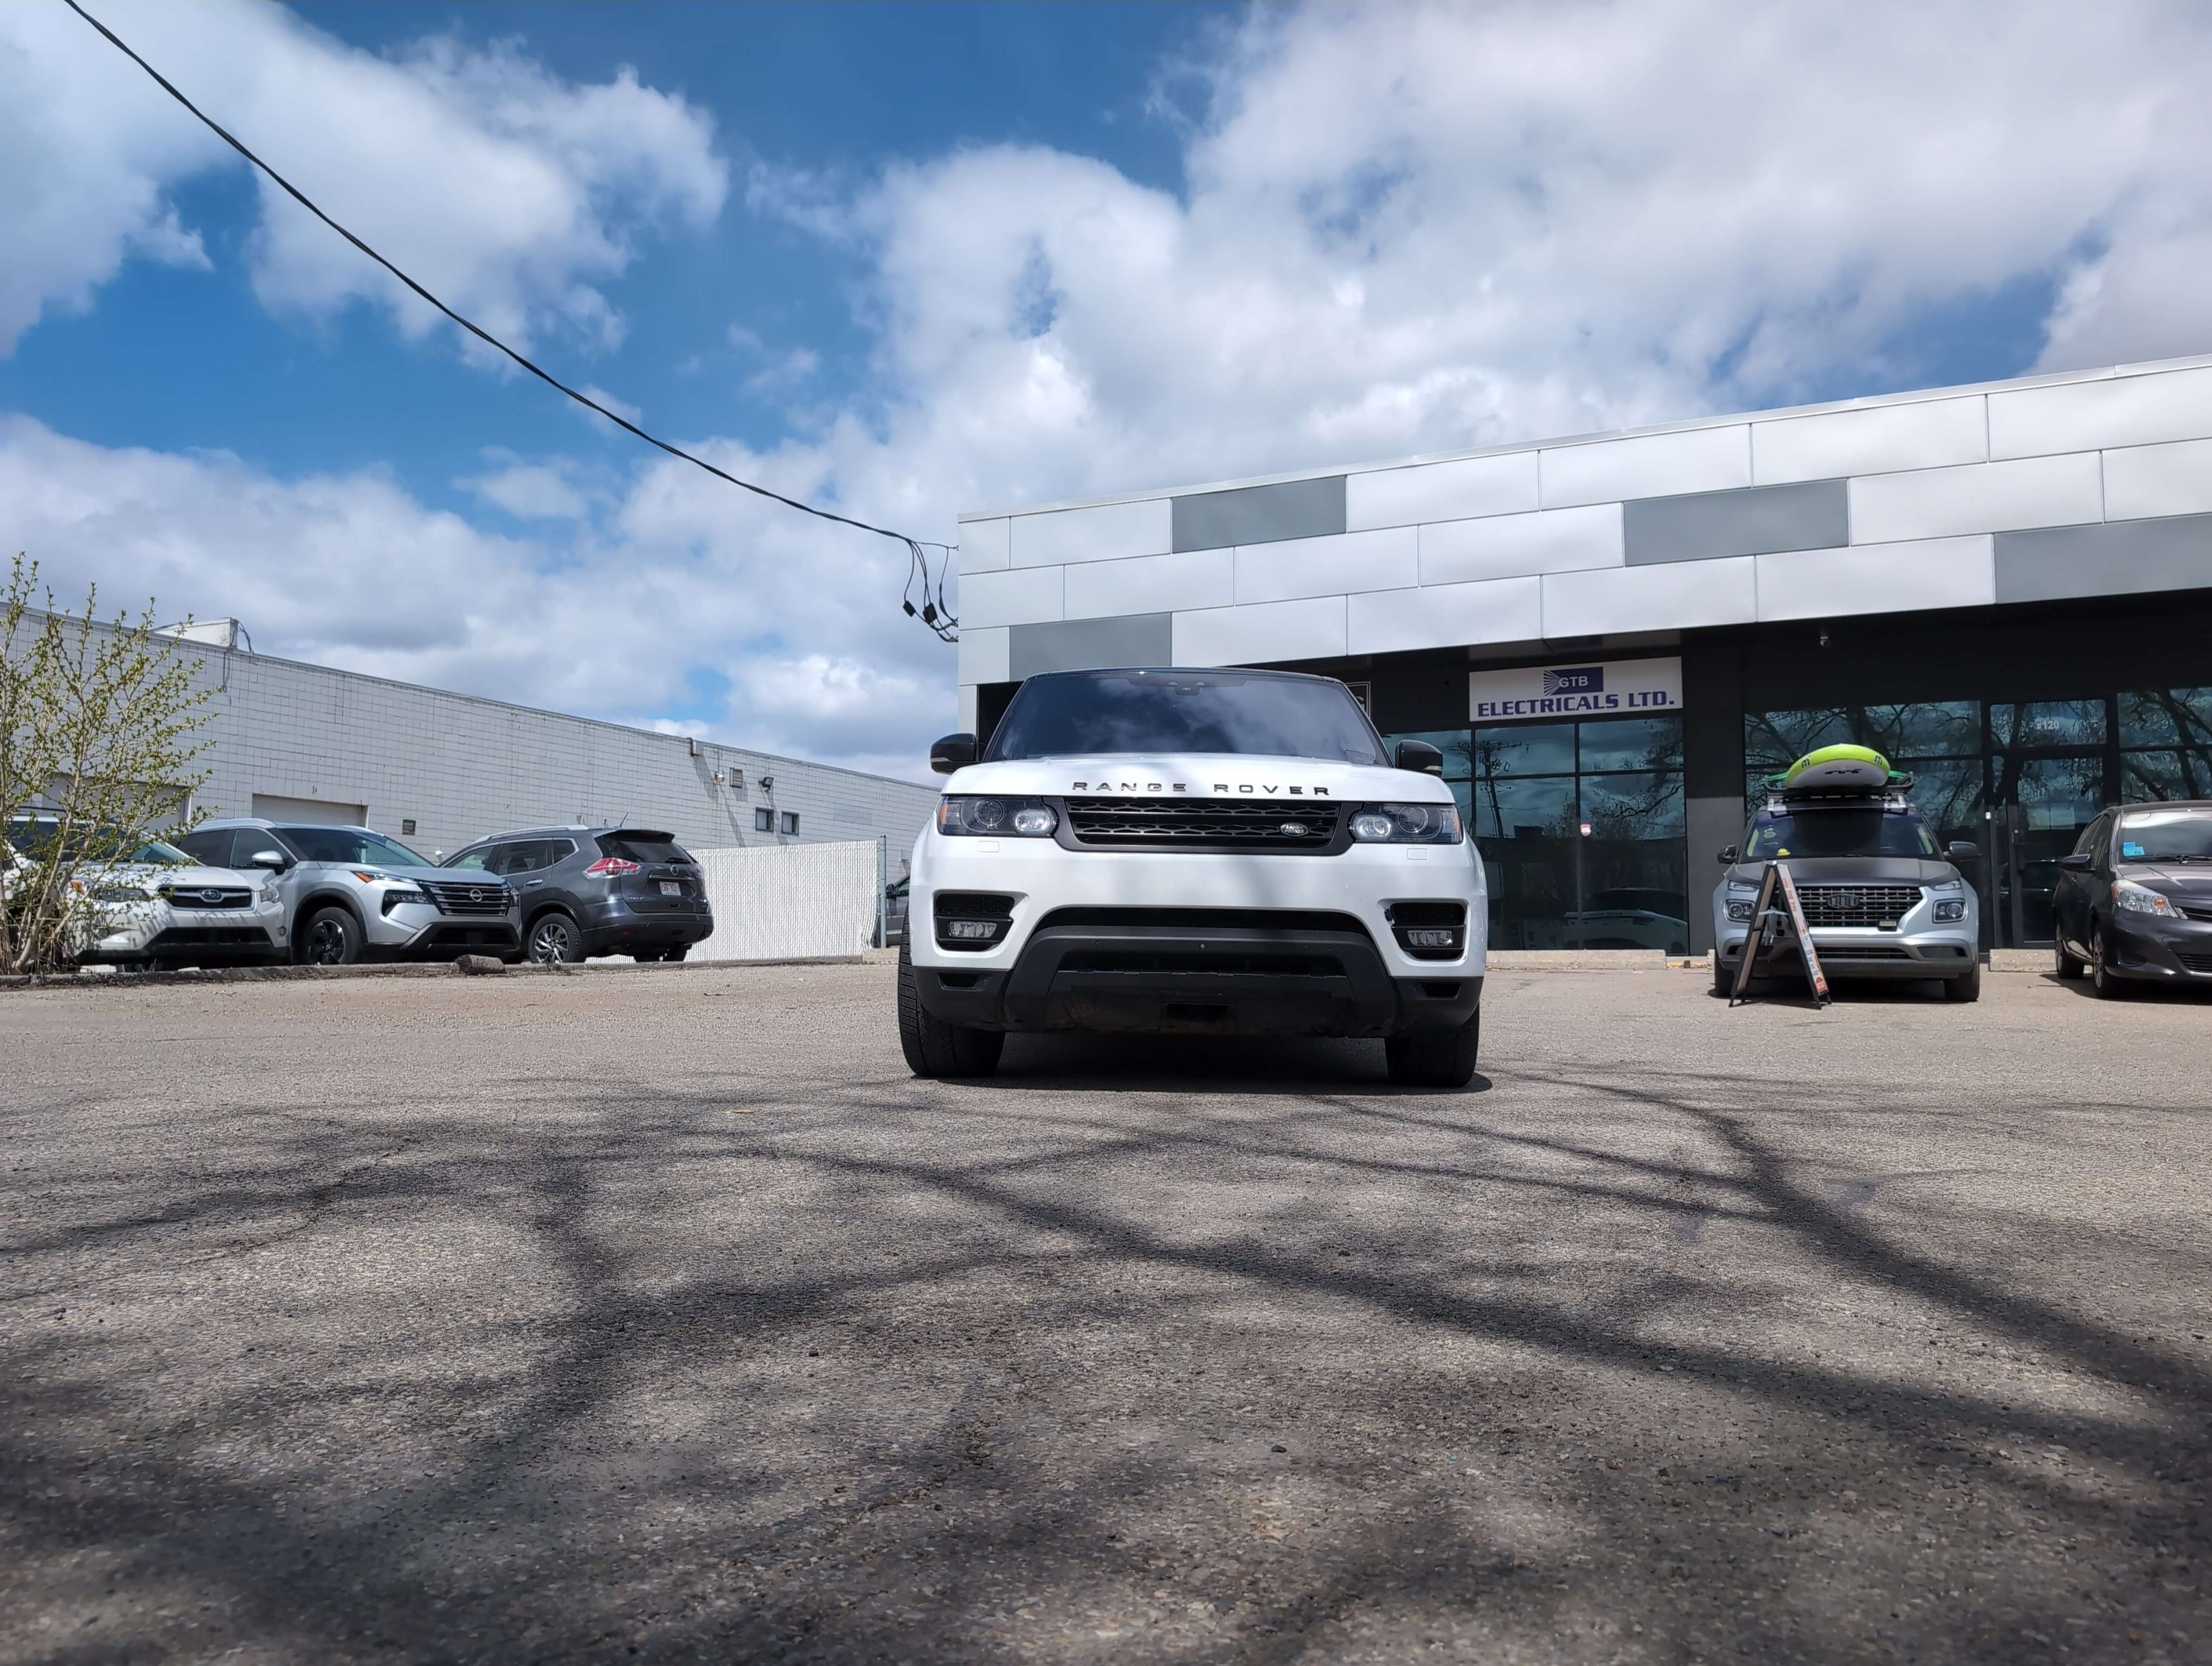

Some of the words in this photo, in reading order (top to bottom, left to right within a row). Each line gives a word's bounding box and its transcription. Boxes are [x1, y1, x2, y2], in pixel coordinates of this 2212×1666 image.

[1558, 675, 1589, 688] GTB
[1477, 694, 1619, 717] ELECTRICALS
[1628, 690, 1675, 708] LTD.
[1072, 781, 1187, 792] RANGE
[1213, 784, 1330, 796] ROVER
